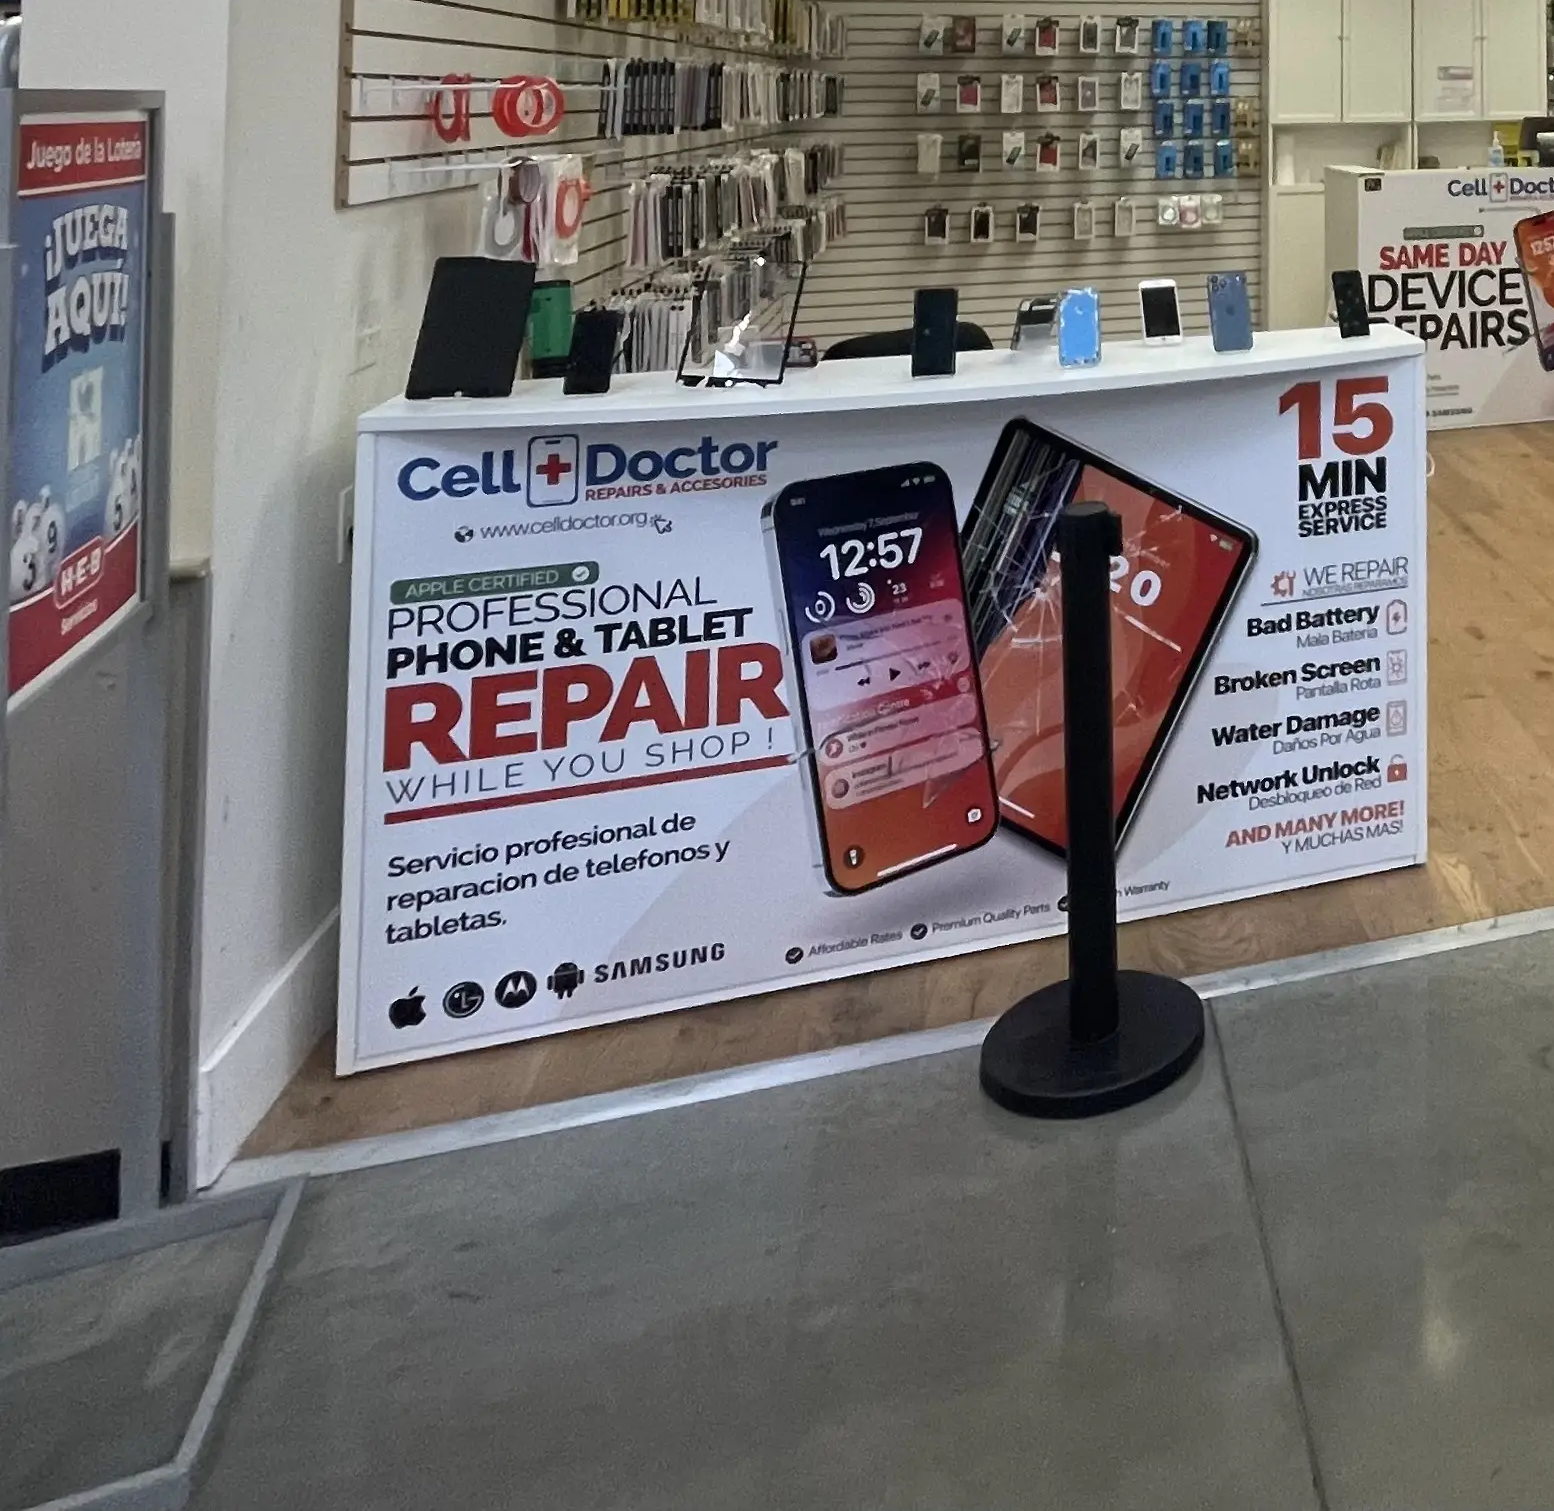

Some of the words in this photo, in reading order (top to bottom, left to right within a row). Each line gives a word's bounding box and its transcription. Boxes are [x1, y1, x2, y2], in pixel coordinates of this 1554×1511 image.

[27, 140, 73, 174] Juego
[75, 137, 92, 166] de
[93, 136, 105, 164] la
[1447, 178, 1488, 197] Cell
[1379, 243, 1450, 271] SAME
[1458, 241, 1508, 267] DAY
[1368, 267, 1524, 313] DEVICE
[1368, 308, 1531, 351] EPAIRS
[1278, 375, 1394, 460] 15
[398, 450, 521, 501] Cell
[585, 436, 779, 485] Doctor
[1298, 456, 1388, 501] MIN
[584, 483, 654, 502] REPAIRS
[656, 481, 669, 496] &
[671, 474, 768, 494] ACCESORIES
[480, 510, 648, 540] www.celldoctor.org
[1298, 495, 1388, 521] EXPRESS
[1298, 512, 1388, 538] SERVICE
[819, 526, 923, 581] 12:57
[1303, 565, 1338, 587] WE
[1341, 556, 1409, 582] REPAIR
[404, 574, 465, 599] APPLE
[468, 569, 560, 594] CERTIFIED
[387, 576, 718, 640] PROFESSIONAL
[1247, 612, 1292, 637] Bad
[1295, 603, 1381, 631] Battery
[386, 631, 546, 680] PHONE
[554, 627, 586, 658] &
[594, 606, 755, 654] TABLET
[1296, 634, 1330, 649] Mala
[1213, 668, 1298, 696] Broken
[1301, 655, 1381, 683] Screen
[1296, 681, 1348, 701] Pantalla
[1351, 676, 1382, 691] Rota
[382, 642, 791, 772] REPAIR
[1211, 720, 1283, 747] Water
[1285, 705, 1381, 736] Damage
[1272, 738, 1318, 755] Daños
[1320, 732, 1343, 747] Por
[1345, 726, 1382, 744] Agua
[386, 763, 525, 805] WHILE
[543, 748, 626, 783] YOU
[645, 730, 751, 768] SHOP
[766, 727, 774, 750] !
[1196, 770, 1298, 805] Network
[1302, 755, 1381, 785] Unlock
[1248, 784, 1333, 812] Desbloqueo
[1334, 780, 1352, 797] de
[1354, 774, 1382, 792] Red
[1225, 822, 1272, 848] AND
[1274, 810, 1338, 839] MANY
[1341, 799, 1405, 827] MORE!
[1281, 840, 1293, 855] Y
[1294, 827, 1365, 853] MUCHAS
[1366, 820, 1404, 838] MAS!
[387, 843, 500, 878] Servicio
[505, 817, 657, 868] profesional
[660, 812, 697, 835] de
[386, 871, 538, 913] reparacion
[543, 862, 580, 886] de
[585, 840, 711, 879] telefonos
[714, 838, 731, 864] y
[1123, 880, 1171, 898] Warranty
[385, 909, 508, 945] tabletas.
[931, 916, 982, 934] Premium
[983, 908, 1021, 926] Quality
[1023, 901, 1051, 918] Parts
[594, 942, 726, 984] SAMSUNG
[808, 936, 869, 959] Affordable
[870, 929, 904, 948] Rates
